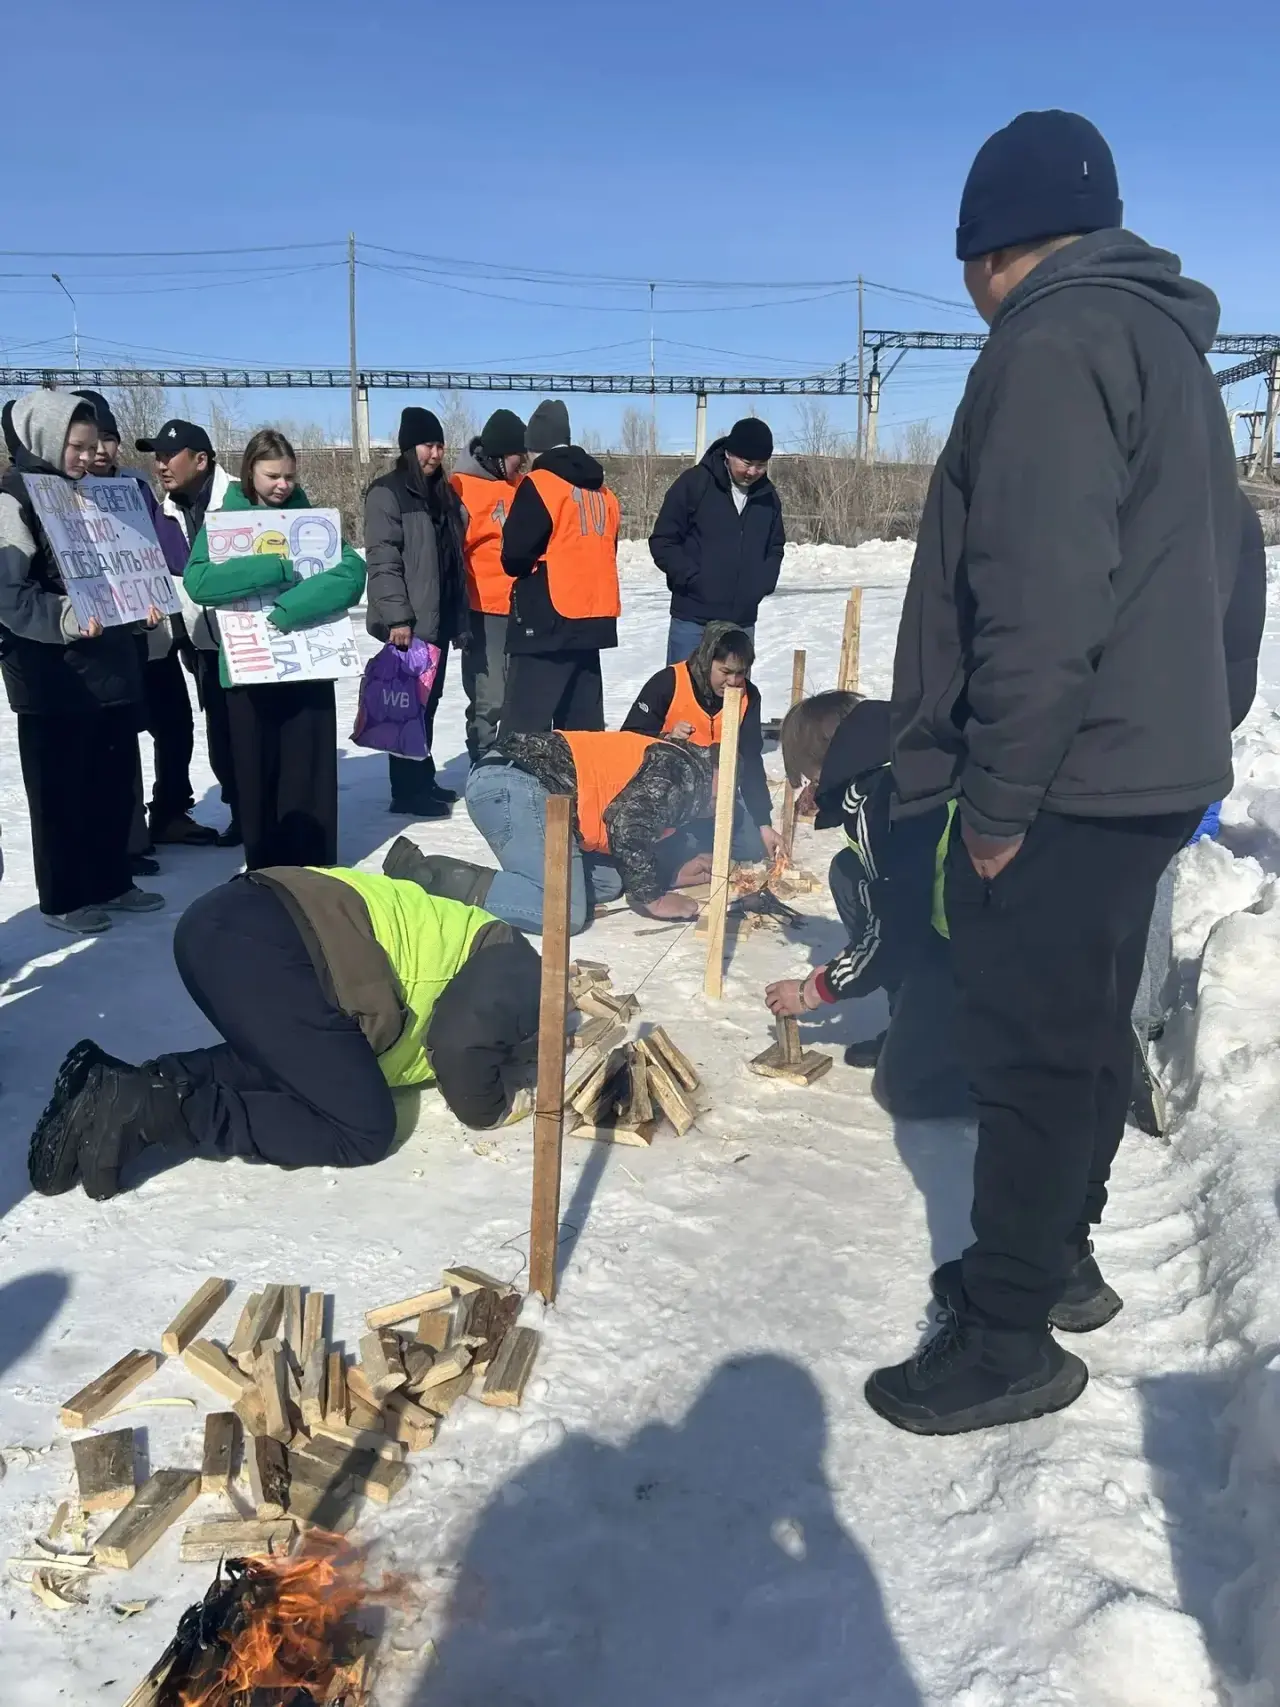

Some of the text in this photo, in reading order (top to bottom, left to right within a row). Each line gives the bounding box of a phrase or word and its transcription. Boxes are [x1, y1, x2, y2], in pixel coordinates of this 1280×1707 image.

[91, 484, 143, 512] СВЕТИ
[571, 486, 606, 536] 10
[139, 547, 167, 571] НАС
[382, 688, 410, 708] WB
